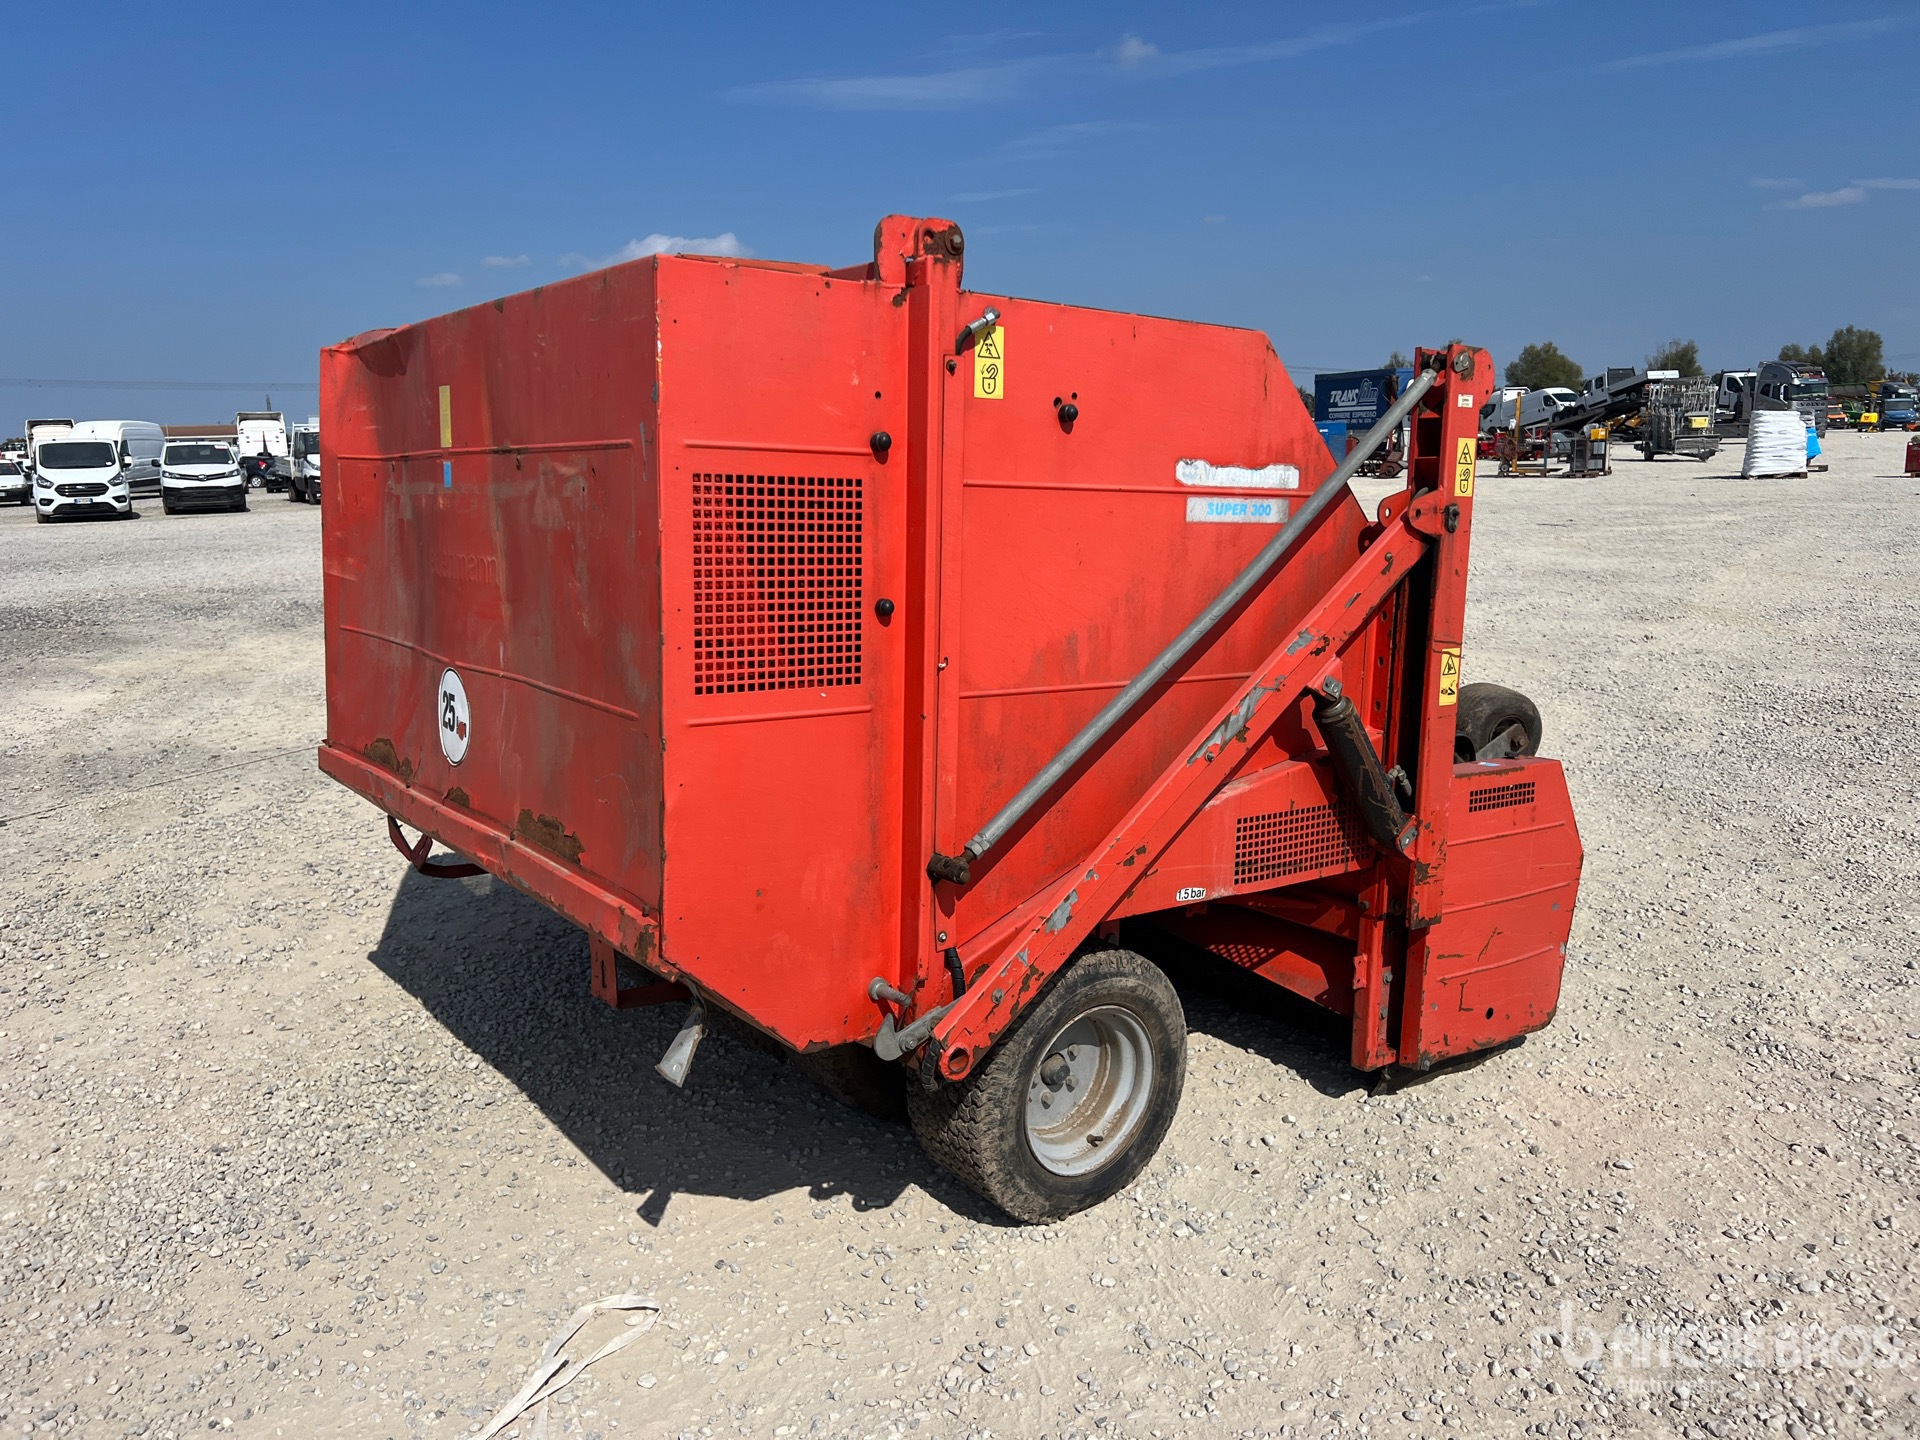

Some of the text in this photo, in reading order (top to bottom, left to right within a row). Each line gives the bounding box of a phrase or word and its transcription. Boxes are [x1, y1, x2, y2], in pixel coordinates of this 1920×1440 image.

[1207, 503, 1272, 516] SUPER 300
[442, 690, 456, 732] 25
[1190, 888, 1205, 898] bar
